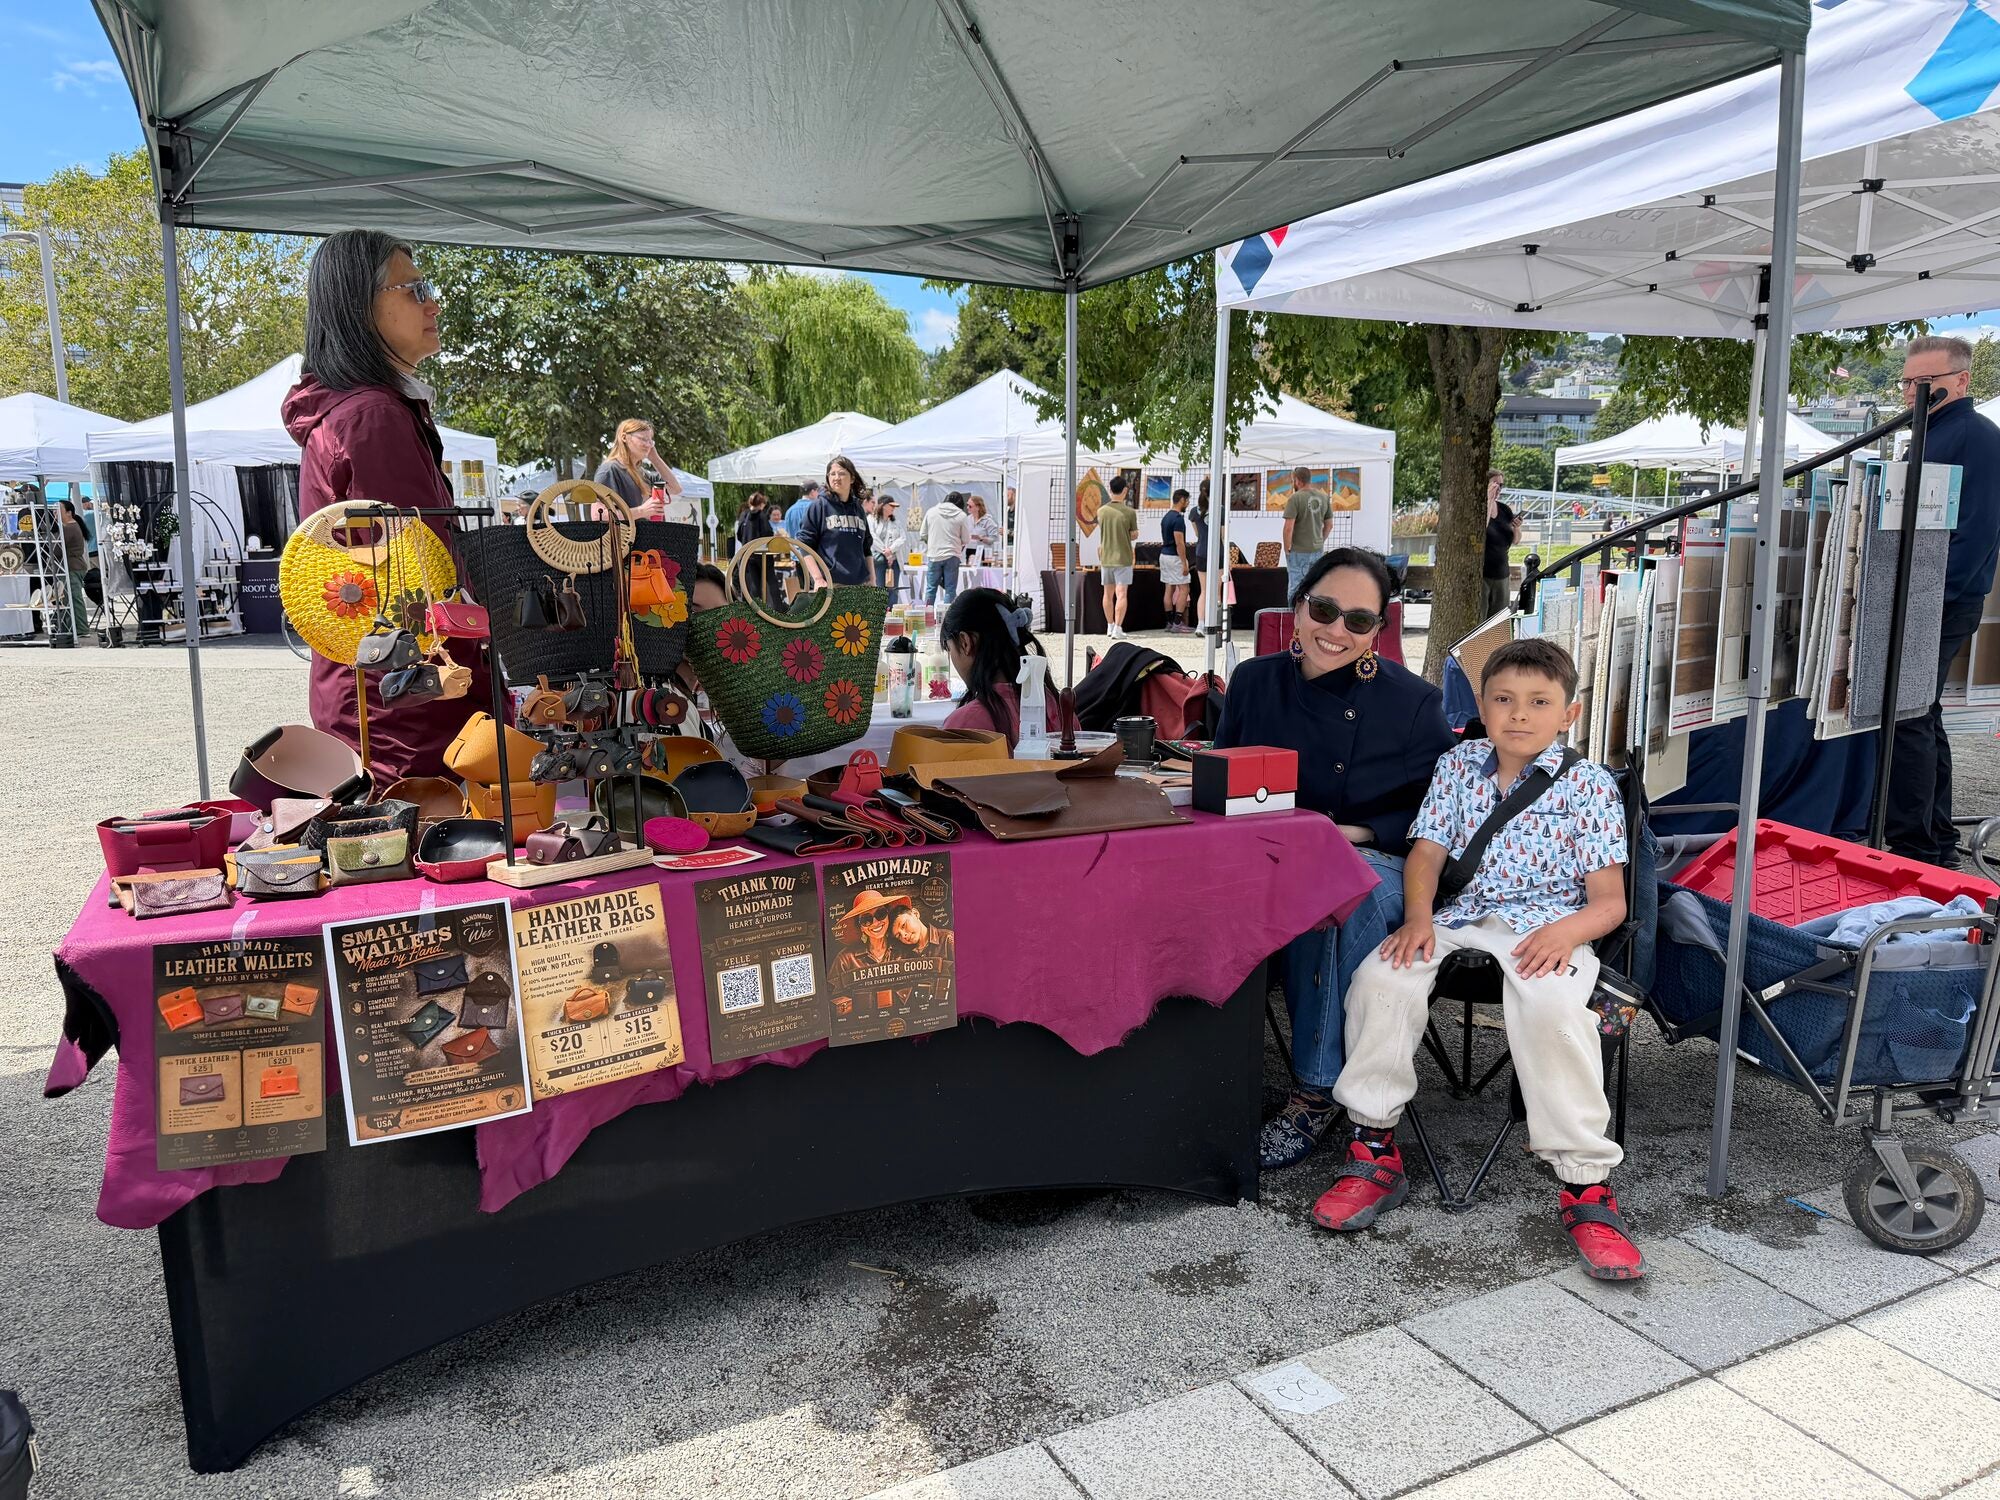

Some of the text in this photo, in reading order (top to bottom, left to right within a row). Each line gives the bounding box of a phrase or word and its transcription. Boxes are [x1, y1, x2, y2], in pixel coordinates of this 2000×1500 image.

[841, 858, 932, 887] HANDMADE
[718, 876, 797, 902] THANK YOU
[890, 879, 914, 887] PURPOSE
[528, 890, 640, 928] HANDMADE
[725, 894, 793, 917] HANDMADE
[461, 913, 493, 924] HANDMADE
[516, 904, 656, 948] LEATHER BAGS
[728, 918, 753, 929] HEART
[762, 911, 792, 923] PURPOSE
[341, 920, 413, 948] SMALL
[463, 927, 495, 943] Wes
[544, 941, 560, 949] BUILT
[603, 928, 617, 936] WITH
[202, 941, 281, 957] HANDMADE
[342, 925, 452, 964] WALLETS
[776, 942, 805, 956] VENMO
[164, 951, 312, 977] LEATHER WALLETS
[355, 957, 391, 974] Made
[391, 952, 406, 967] by
[530, 957, 545, 966] HIGH
[723, 953, 750, 967] ZELLE
[520, 968, 531, 976] ALL
[550, 961, 559, 970] NO
[853, 959, 934, 982] LEATHER GOODS
[215, 974, 237, 982] MADE
[625, 1015, 652, 1034] $15
[755, 1021, 797, 1037] DIFFERENCE
[550, 1032, 583, 1053] $20
[175, 1053, 229, 1065] THICK LEATHER
[256, 1047, 304, 1058] THIN LEATHER
[272, 1056, 287, 1064] $20
[193, 1064, 207, 1072] $25
[571, 1063, 590, 1072] HAND
[594, 1057, 612, 1066] MADE
[371, 1094, 386, 1102] REAL
[416, 1086, 430, 1094] REAL
[466, 1077, 479, 1085] REAL
[376, 1118, 392, 1128] USA
[1373, 1169, 1396, 1184] NIKE
